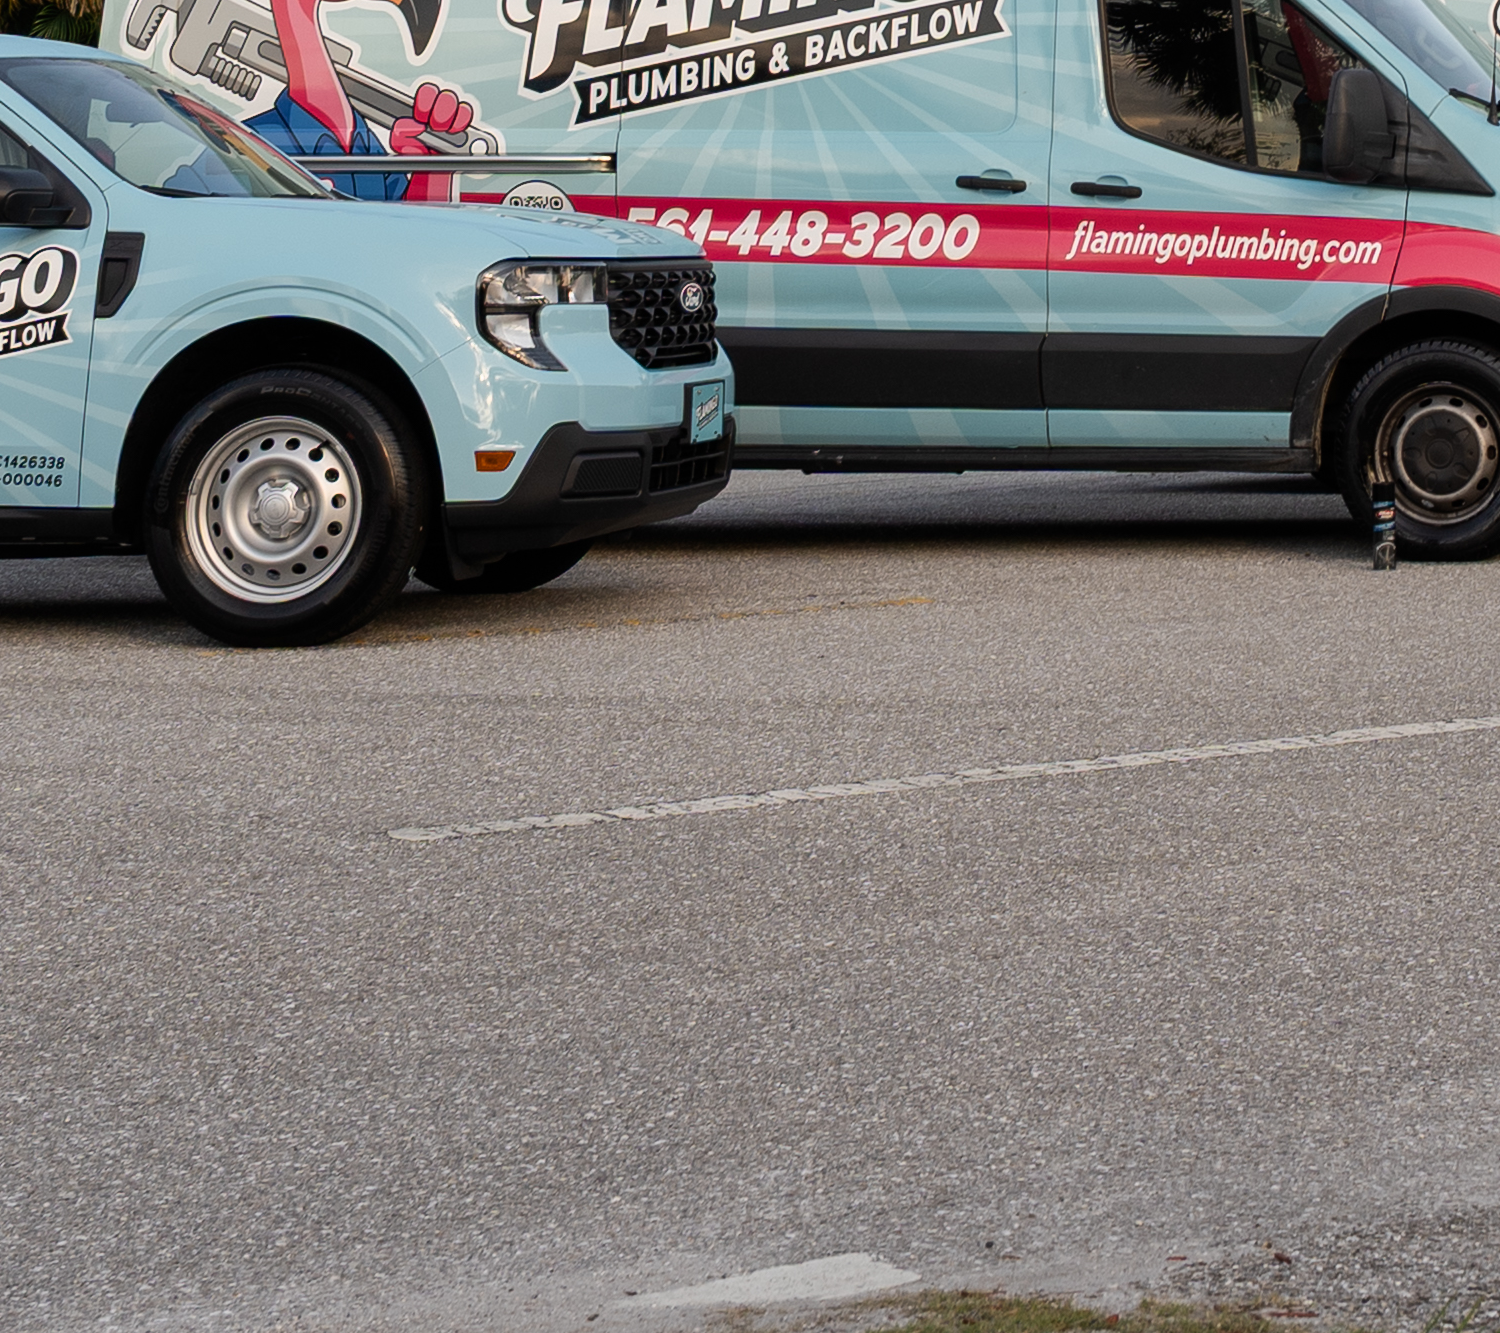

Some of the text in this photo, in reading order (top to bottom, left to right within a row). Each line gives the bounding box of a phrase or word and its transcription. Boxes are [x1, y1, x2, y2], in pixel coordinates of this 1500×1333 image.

[589, 0, 984, 114] PLUMBING & BACKFLOW
[1065, 220, 1382, 270] flamingoplumbing.com
